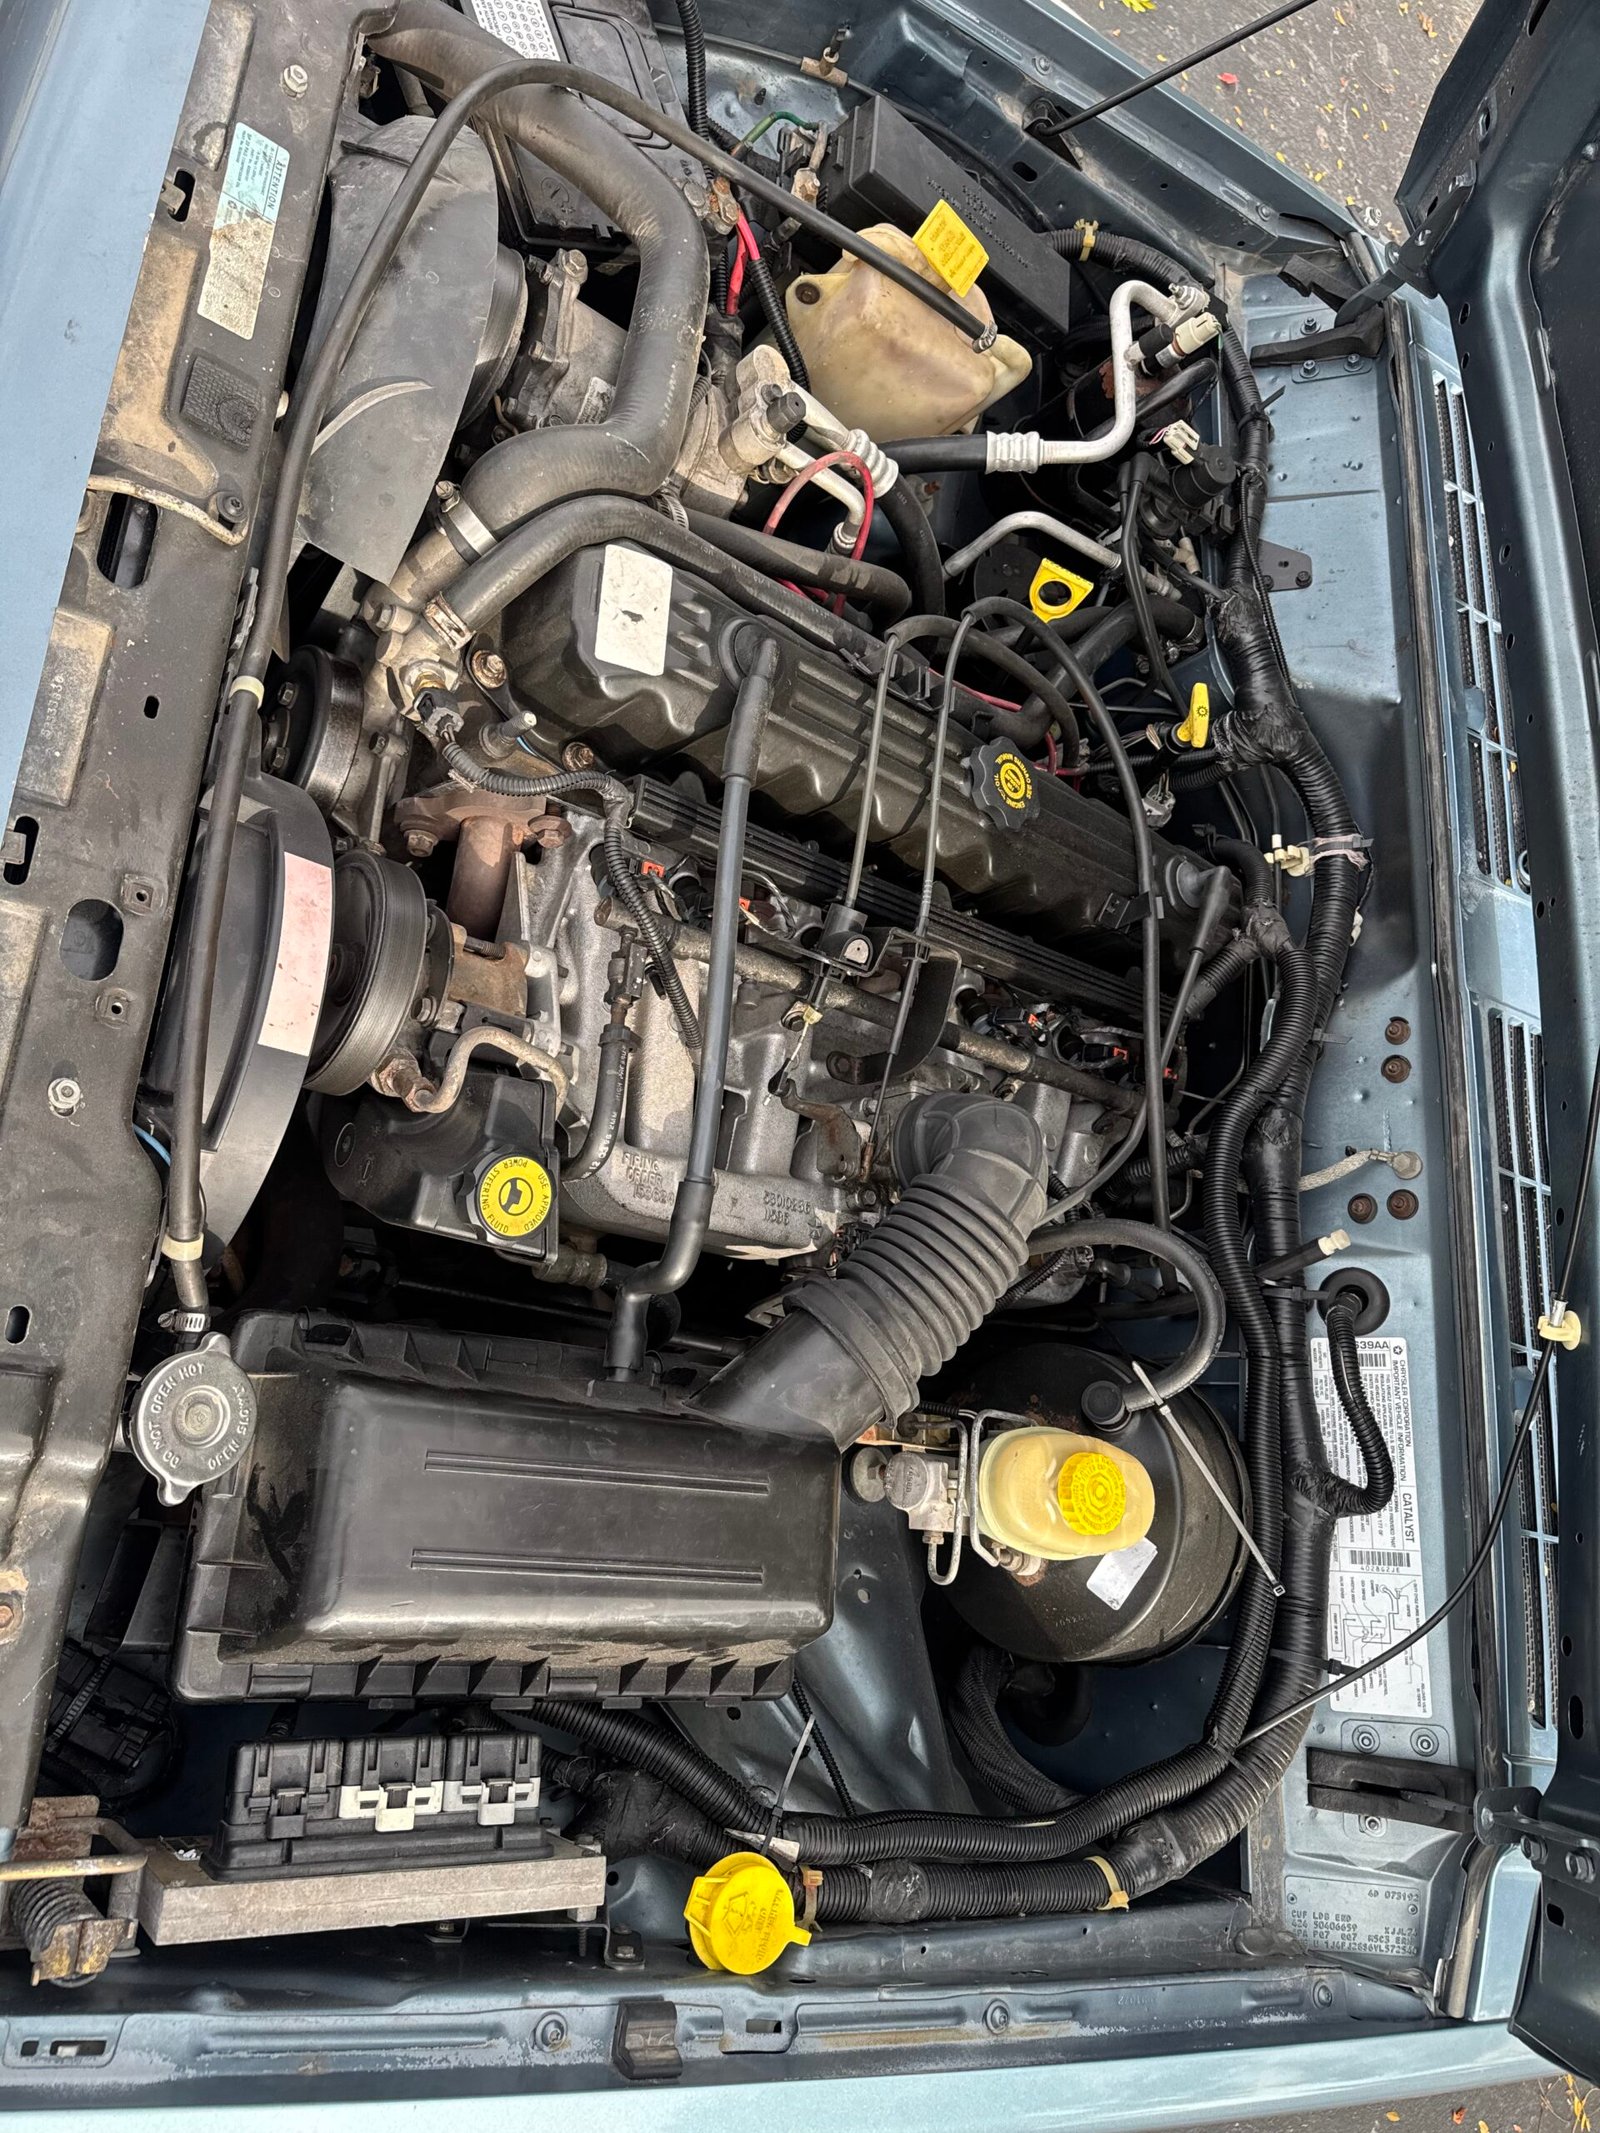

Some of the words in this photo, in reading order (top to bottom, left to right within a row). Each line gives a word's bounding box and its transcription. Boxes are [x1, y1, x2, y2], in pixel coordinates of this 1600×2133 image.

[267, 160, 286, 209] ATTENTION
[503, 1159, 528, 1169] POWER
[622, 1152, 659, 1172] FIRING
[626, 1167, 663, 1187] ORDER
[482, 1168, 500, 1210] STEERING
[538, 1173, 549, 1189] USE
[487, 1214, 508, 1233] FLUID
[524, 1195, 549, 1231] APPROVED
[179, 1362, 205, 1380] HOT
[1392, 1360, 1401, 1400] IMPORTANT
[1399, 1360, 1408, 1395] CHRYSLER
[151, 1376, 177, 1413] OPEN
[209, 1439, 239, 1469] OPEN
[232, 1383, 251, 1435] SLOWLY
[1395, 1402, 1403, 1430] VEHICLE
[1401, 1398, 1412, 1447] CORPORATION
[149, 1421, 164, 1450] NOT
[163, 1450, 181, 1468] DO
[1397, 1432, 1407, 1481] INFORMATION
[1402, 1493, 1415, 1543] CATALYST
